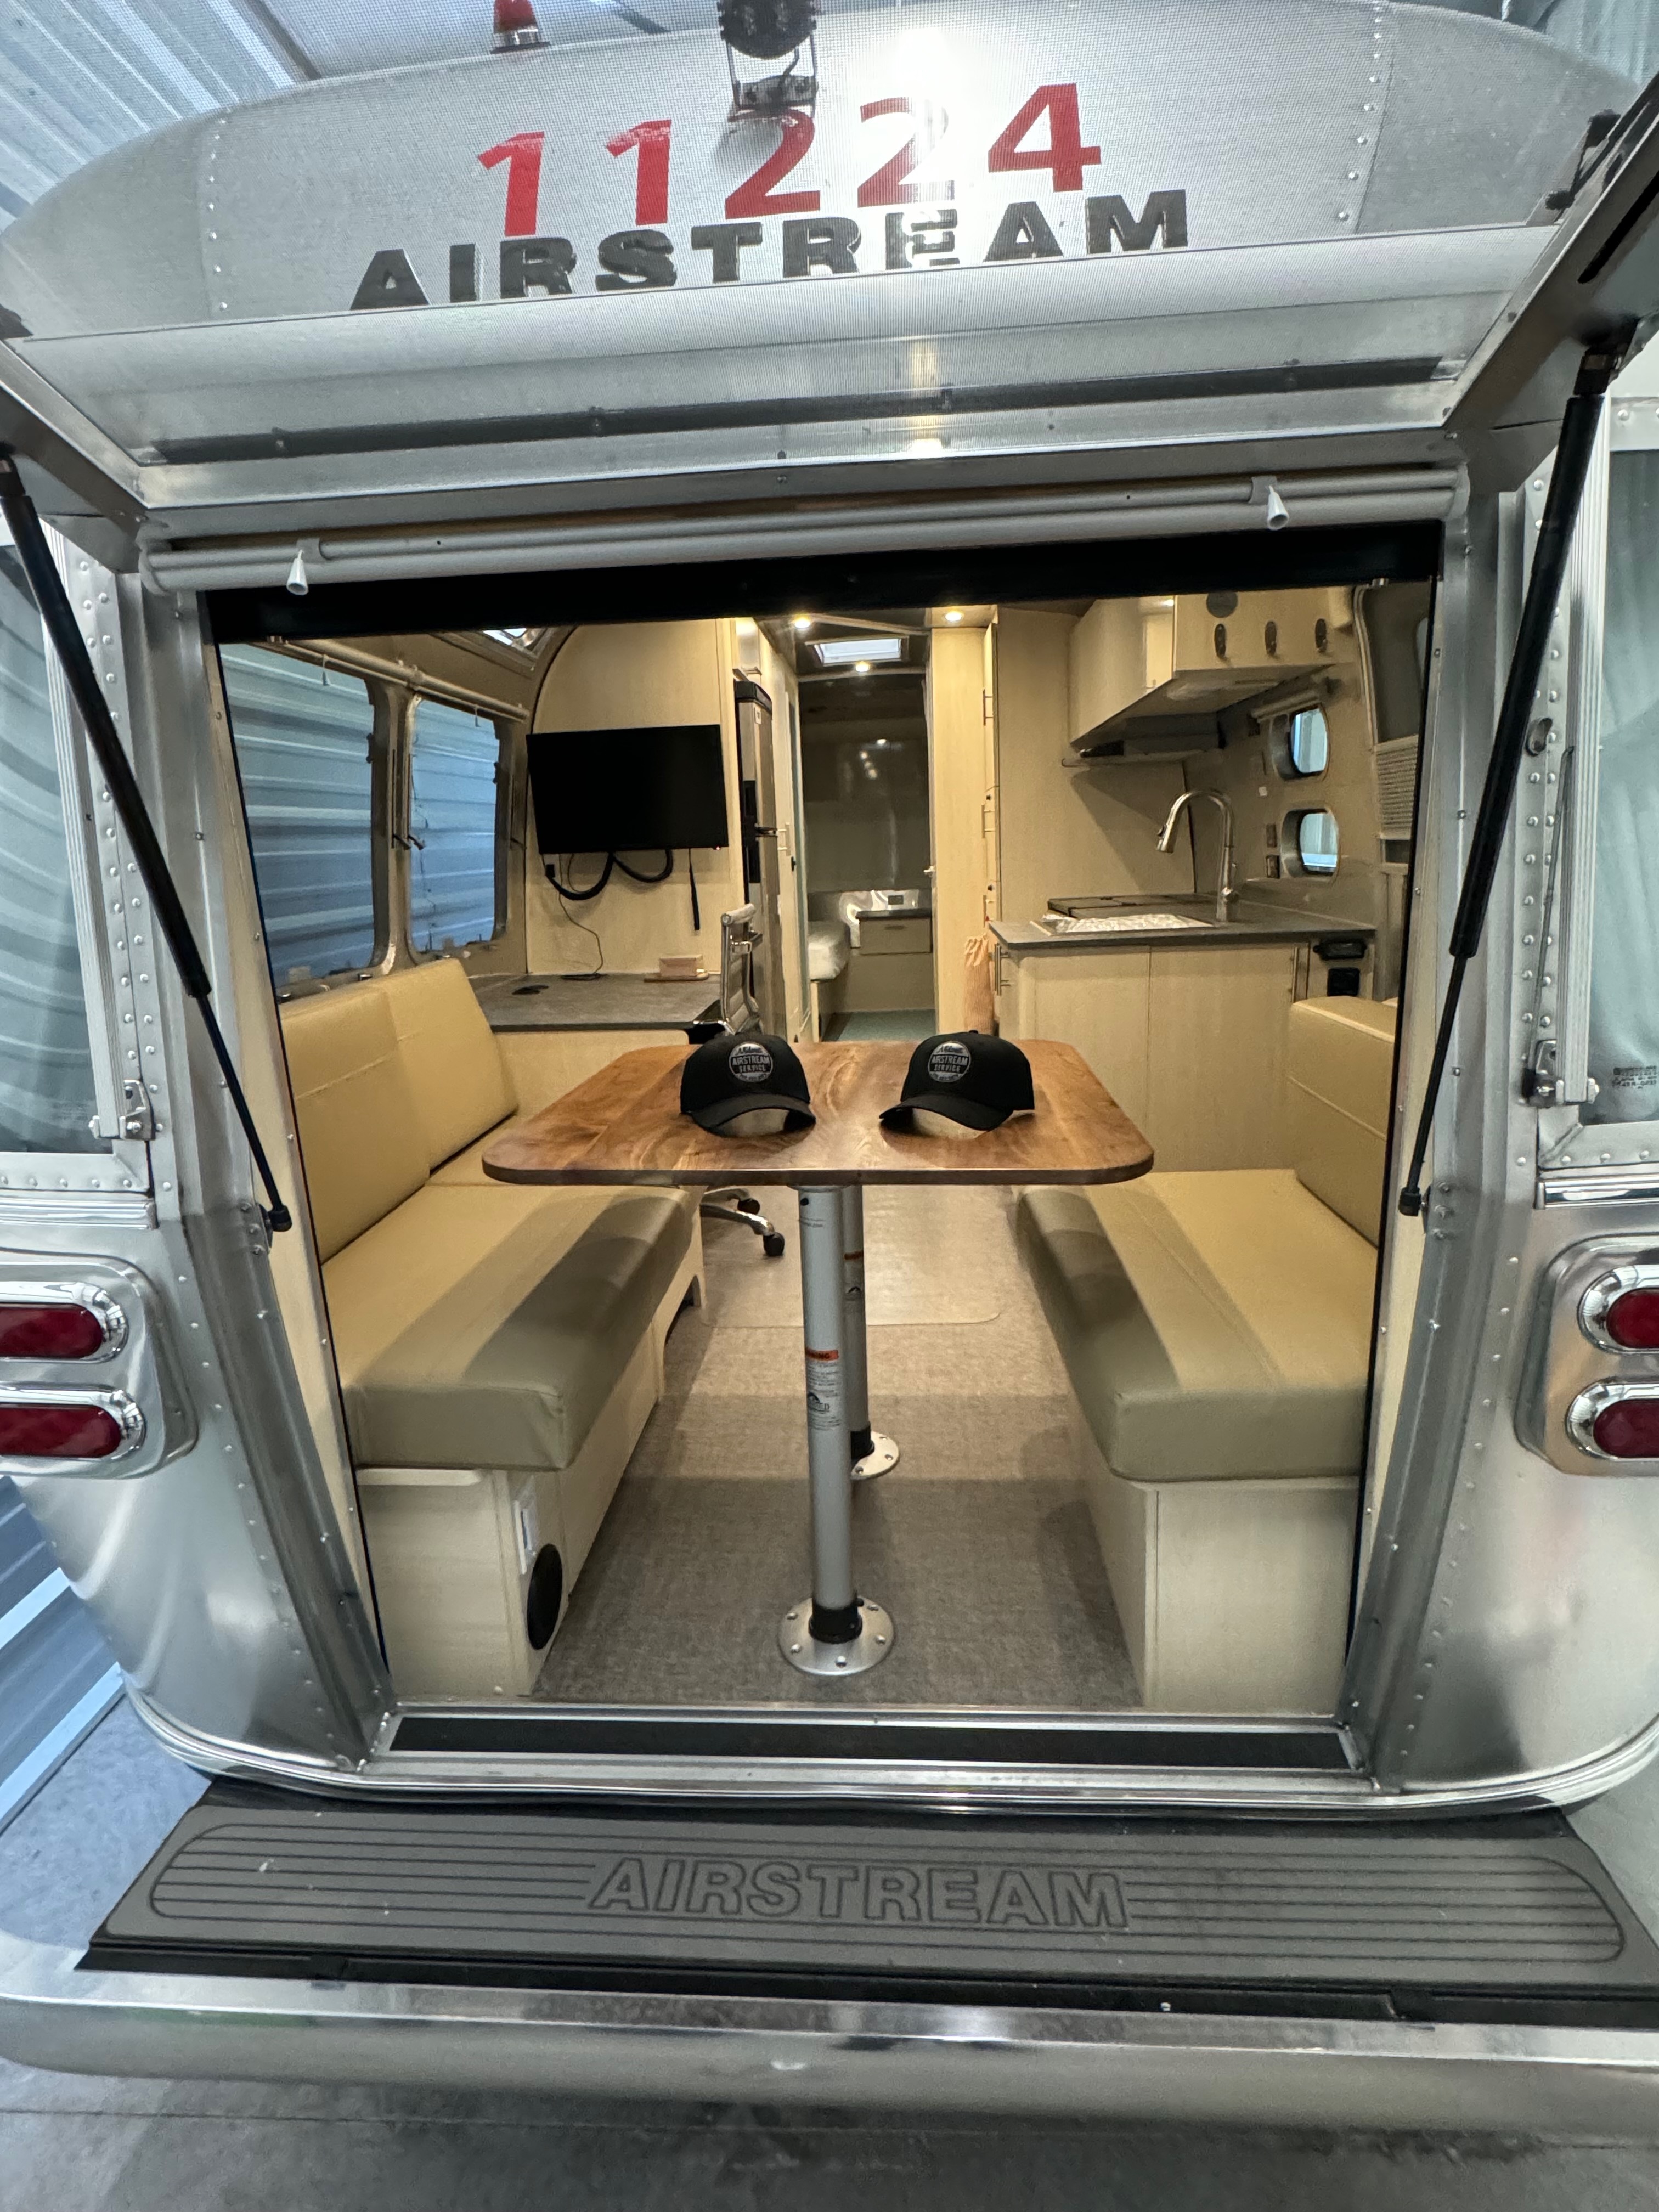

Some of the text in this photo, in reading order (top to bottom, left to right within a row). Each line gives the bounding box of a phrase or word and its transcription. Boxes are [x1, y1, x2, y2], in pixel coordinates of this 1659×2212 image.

[478, 83, 1101, 236] 11224
[351, 189, 1188, 309] AIRSTREAM
[732, 1055, 770, 1066] AIRSTREAM
[931, 1055, 968, 1065] AIRSTREAM
[587, 1858, 1130, 1927] AIRSTREAM
